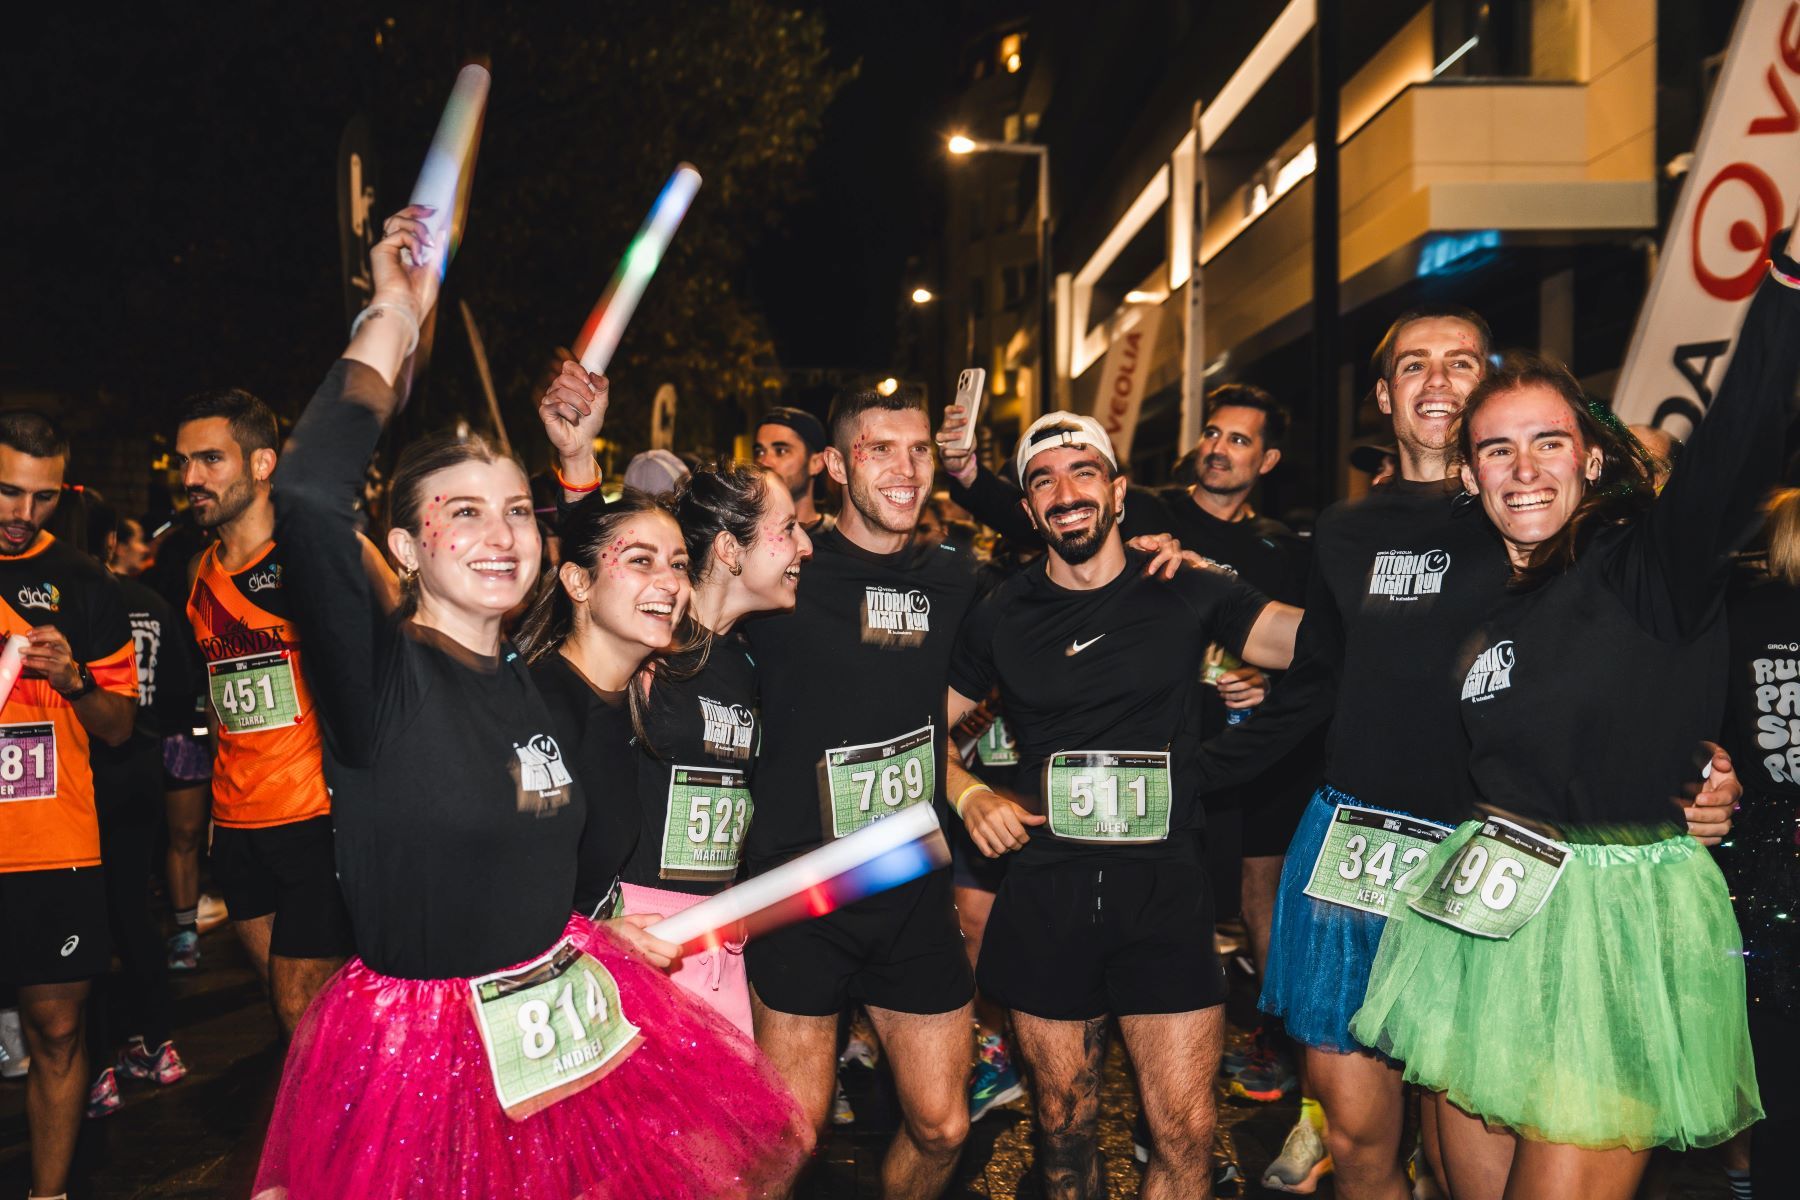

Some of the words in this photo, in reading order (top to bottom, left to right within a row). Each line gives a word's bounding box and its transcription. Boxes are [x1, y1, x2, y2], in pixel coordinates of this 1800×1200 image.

[1106, 332, 1143, 434] VEOLIA
[1373, 554, 1426, 574] VITORIA
[1369, 574, 1413, 594] NIGHT
[1413, 571, 1443, 594] RUN
[865, 591, 912, 613] VITORIA
[867, 609, 903, 630] NIGHT
[905, 612, 930, 632] RUN
[1753, 658, 1800, 685] RU
[222, 674, 275, 714] 451
[239, 715, 265, 727] IZARRA
[852, 757, 924, 811] 769
[1070, 774, 1146, 817] 511
[687, 796, 746, 844] 523
[1094, 821, 1129, 833] JULEN
[693, 849, 728, 861] MARTIN
[1338, 834, 1430, 892] 342
[1357, 889, 1385, 906] KEPA
[517, 968, 609, 1060] 814
